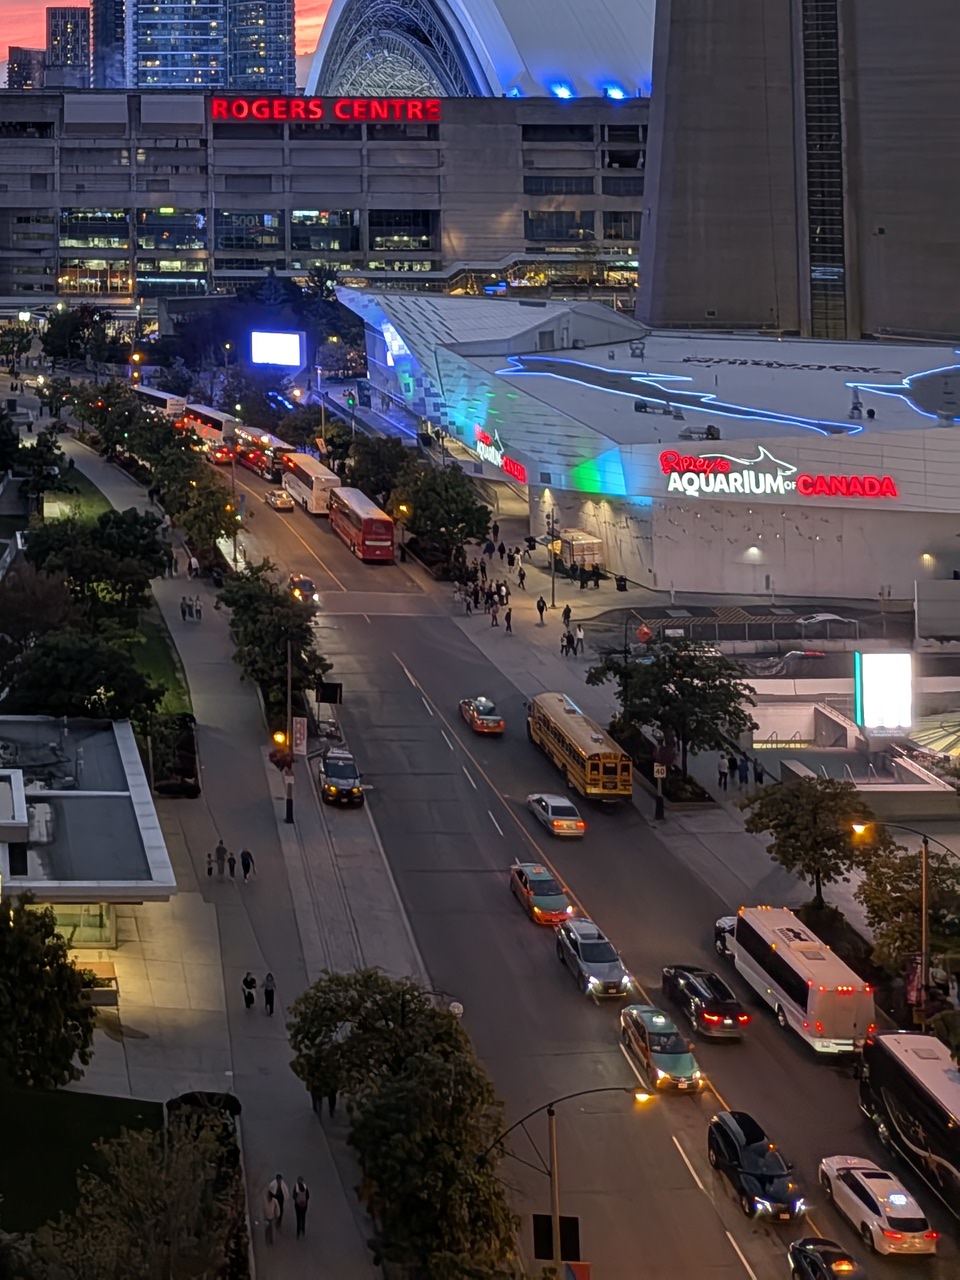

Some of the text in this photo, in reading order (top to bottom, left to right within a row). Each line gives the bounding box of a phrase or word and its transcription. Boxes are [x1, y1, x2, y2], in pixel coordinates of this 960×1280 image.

[212, 99, 441, 121] ROGERS CENTRE
[668, 469, 898, 497] AQUARIUM OF CANADA
